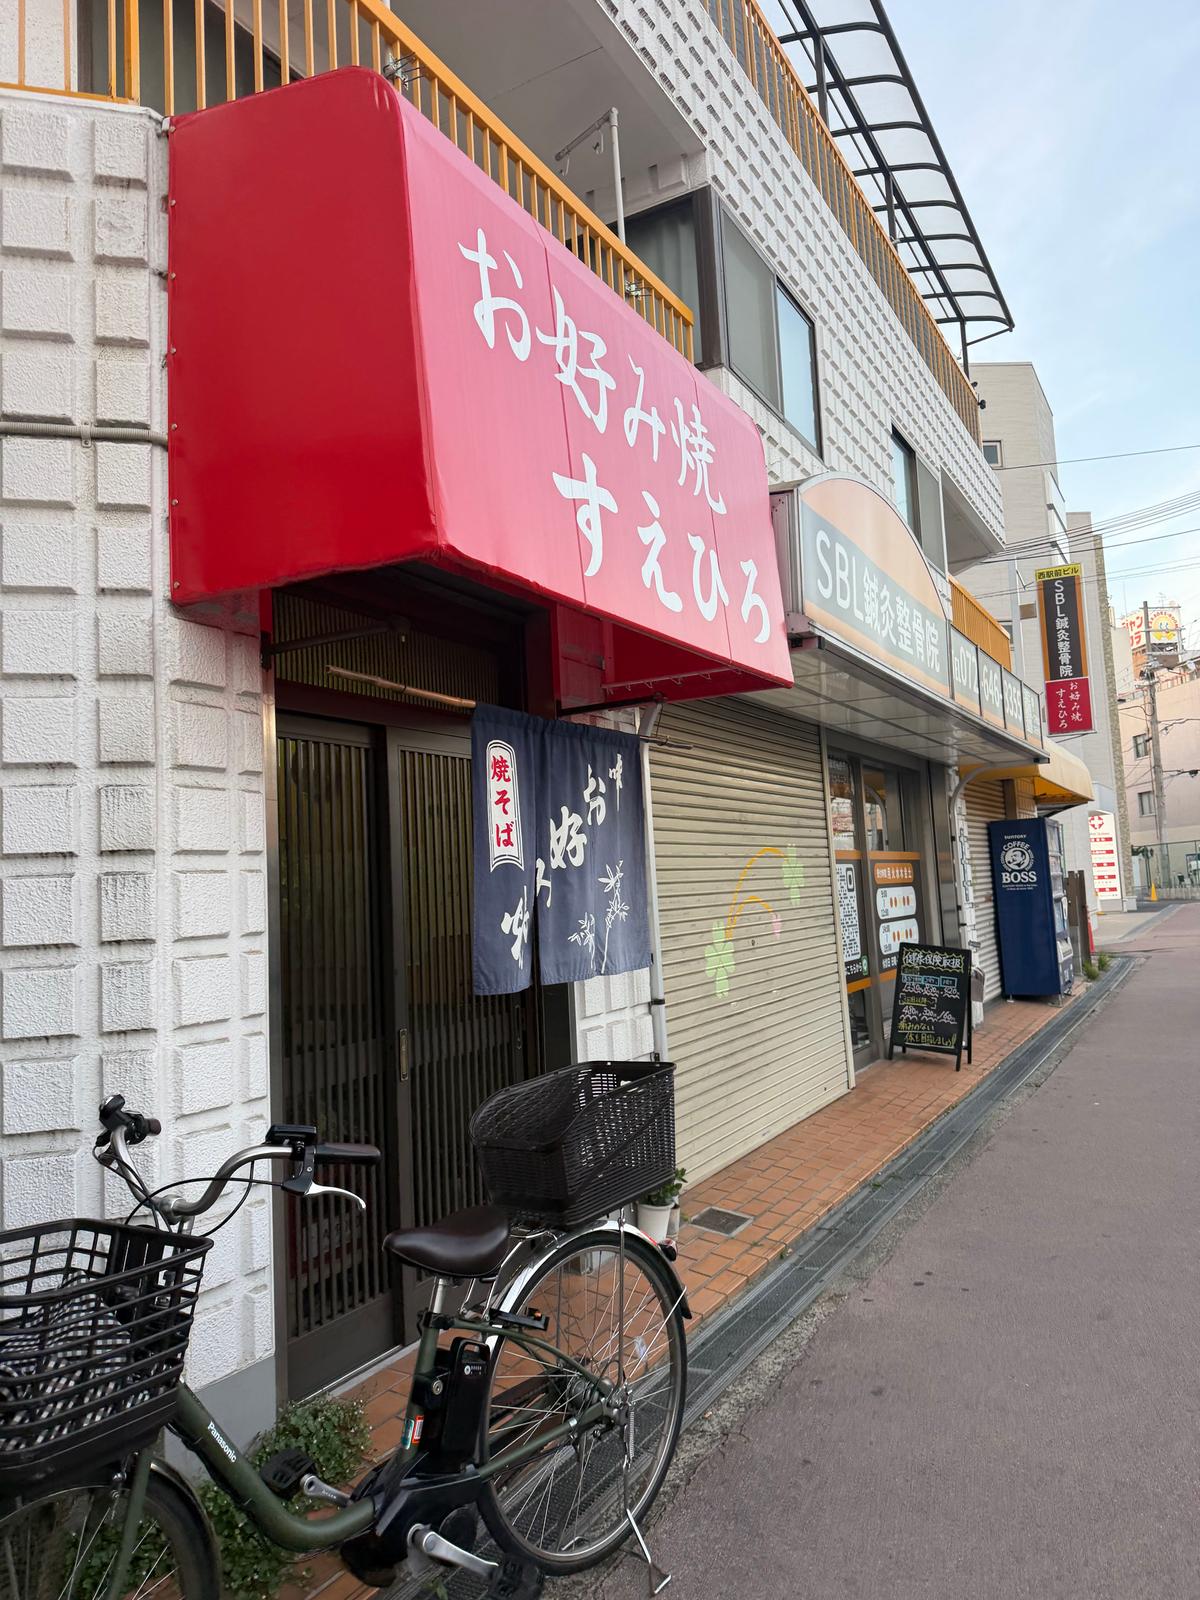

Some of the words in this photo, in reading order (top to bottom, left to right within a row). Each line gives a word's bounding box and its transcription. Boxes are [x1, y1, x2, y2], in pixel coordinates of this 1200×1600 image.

[457, 228, 727, 515] お好み焼
[552, 452, 771, 644] すえひろ
[1037, 566, 1079, 580] 西駅前ビル
[815, 529, 941, 673] SBL鍼灸整骨院
[1054, 579, 1073, 677] SBL鍼灸整骨院
[1055, 688, 1068, 729] すえひろ
[1069, 681, 1083, 722] お好み焼
[490, 755, 514, 848] 焼そば
[1003, 841, 1030, 851] COFFEE
[1001, 871, 1037, 884] BOSS
[207, 1421, 237, 1463] Panasonic
